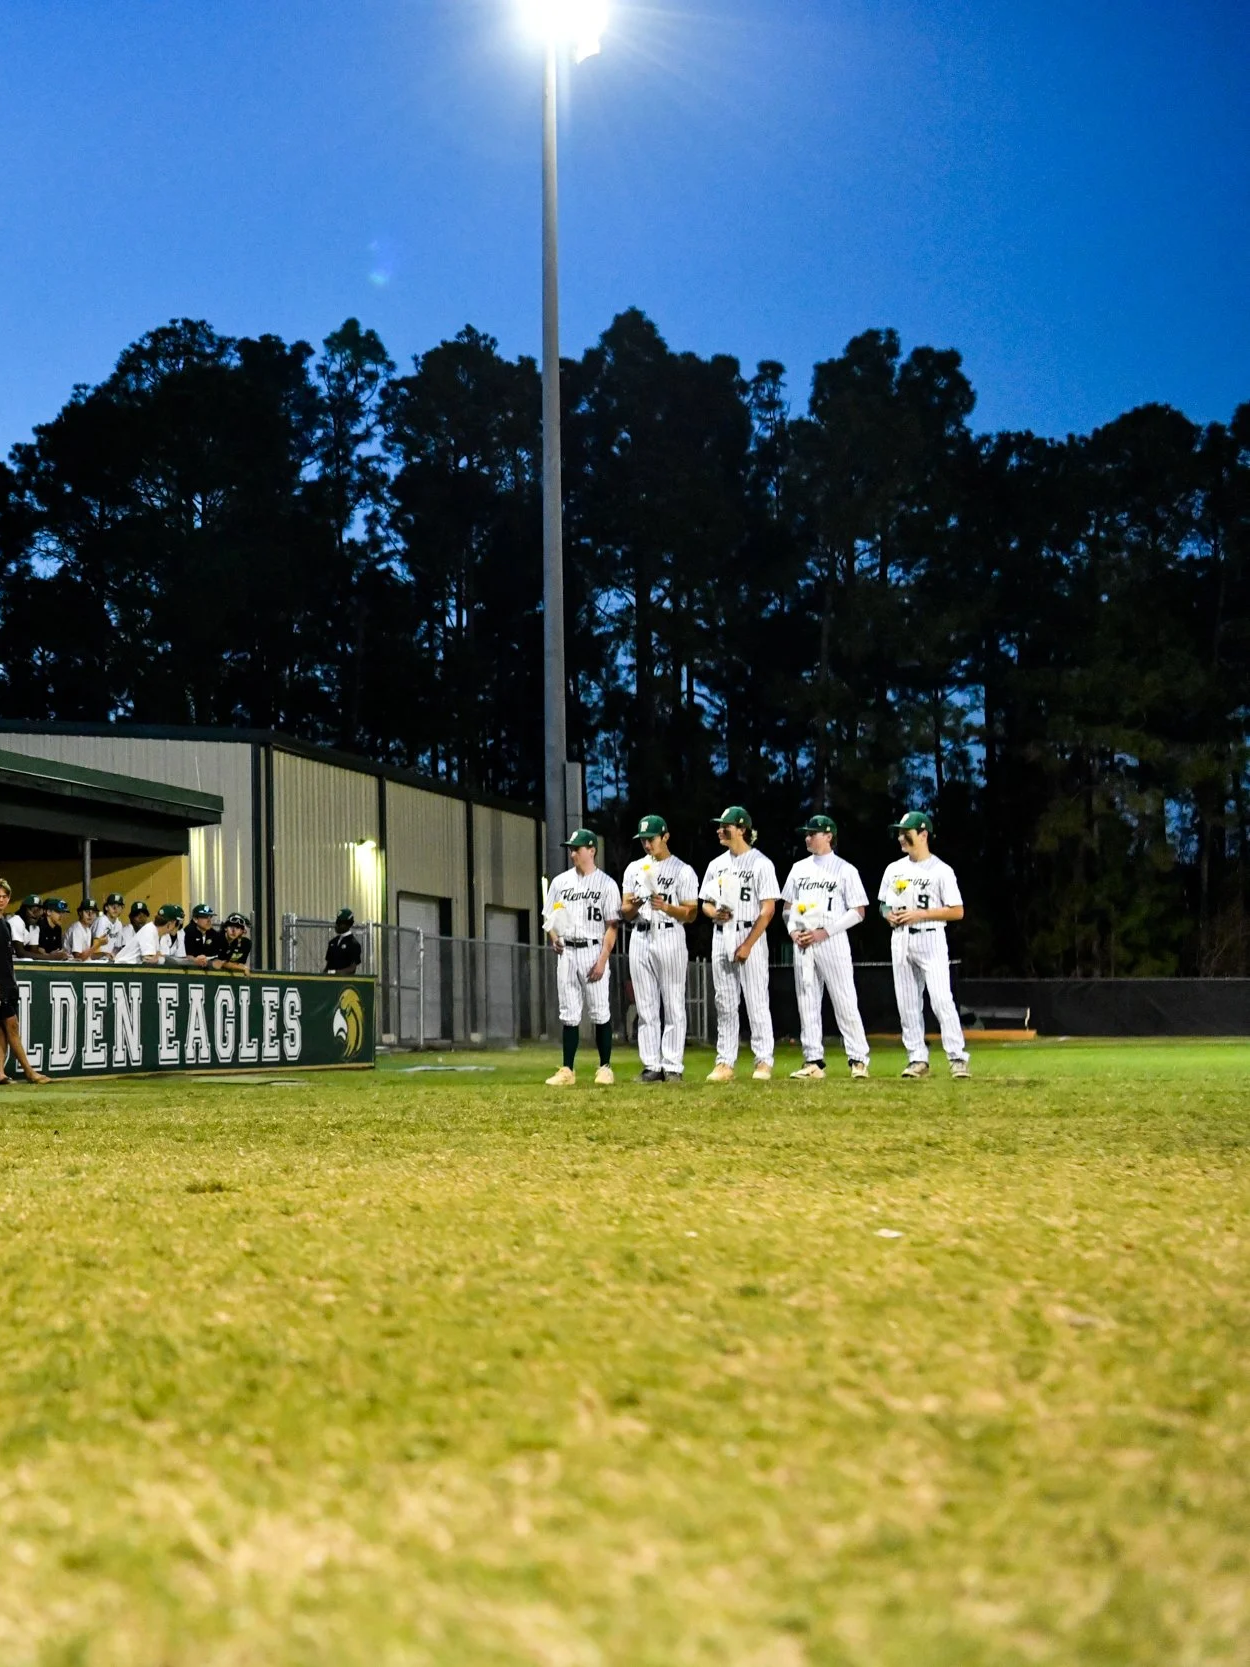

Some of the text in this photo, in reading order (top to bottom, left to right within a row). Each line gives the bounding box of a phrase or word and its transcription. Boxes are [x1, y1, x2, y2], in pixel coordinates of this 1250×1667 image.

[797, 876, 838, 892] Fleming
[560, 887, 602, 904] Fleming
[740, 886, 751, 902] 6
[917, 894, 930, 910] 9
[827, 897, 833, 911] 1
[157, 982, 303, 1065] EAGLES
